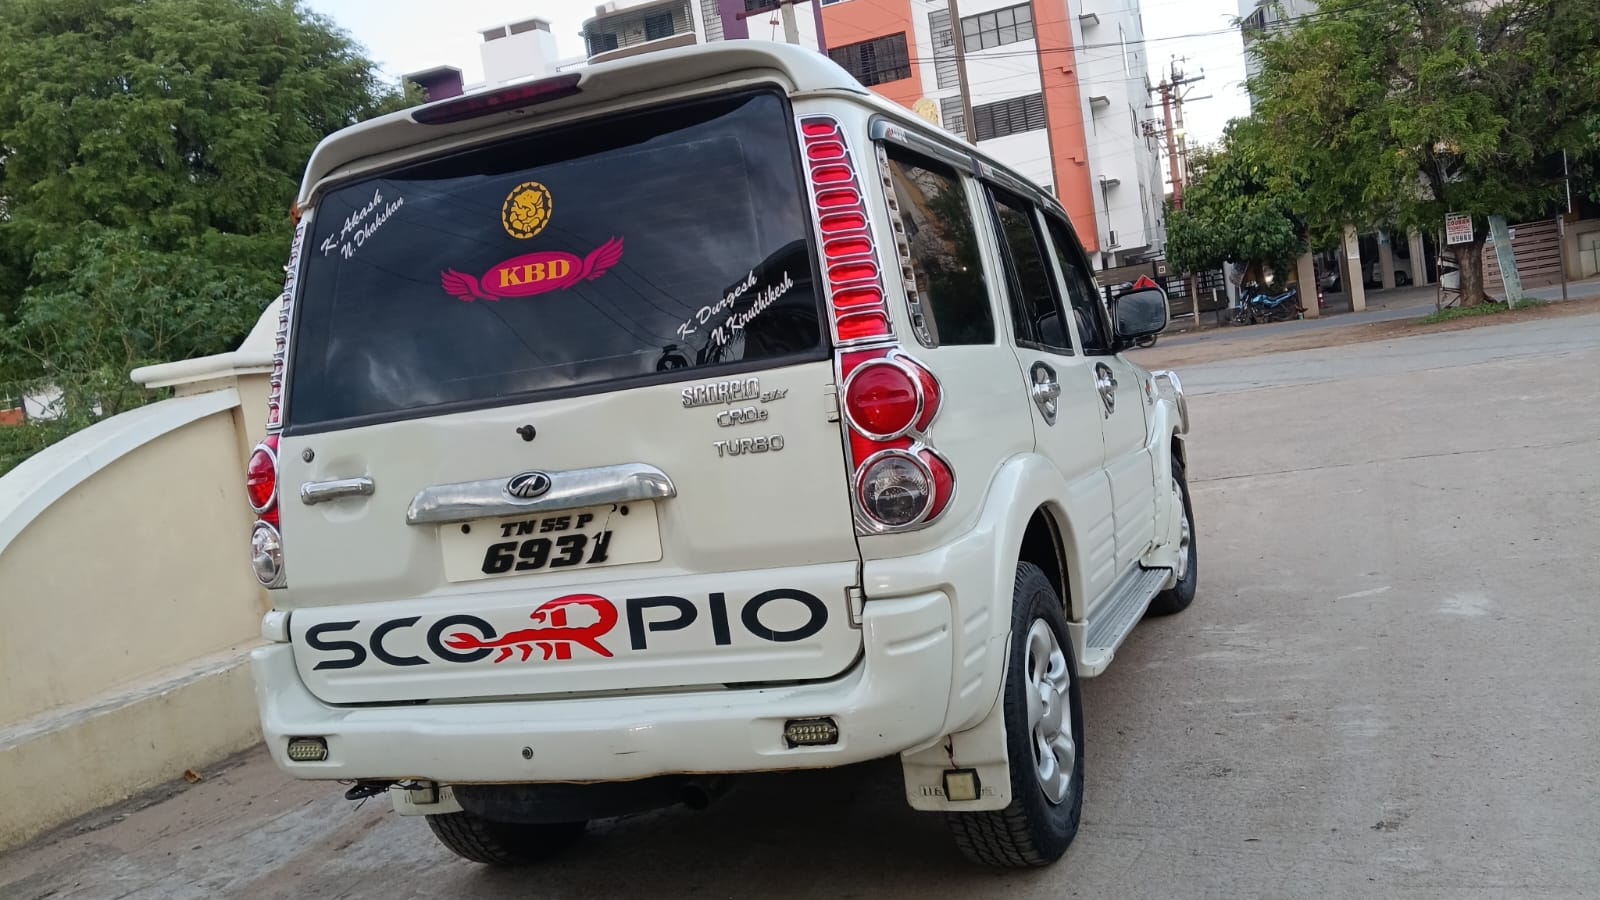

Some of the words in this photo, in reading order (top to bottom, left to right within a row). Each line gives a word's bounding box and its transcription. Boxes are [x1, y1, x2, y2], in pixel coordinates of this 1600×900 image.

[340, 188, 382, 241] Akash
[353, 196, 404, 247] Dhakshan
[498, 258, 571, 289] KBD
[696, 270, 758, 325] Durgesh
[681, 377, 760, 408] SCORPIO
[716, 406, 769, 428] CRDe
[713, 434, 785, 458] TURBO
[500, 520, 533, 538] TN
[539, 516, 571, 534] 55
[576, 513, 594, 529] P
[481, 530, 613, 575] 6931
[304, 588, 829, 671] SCORPIO
